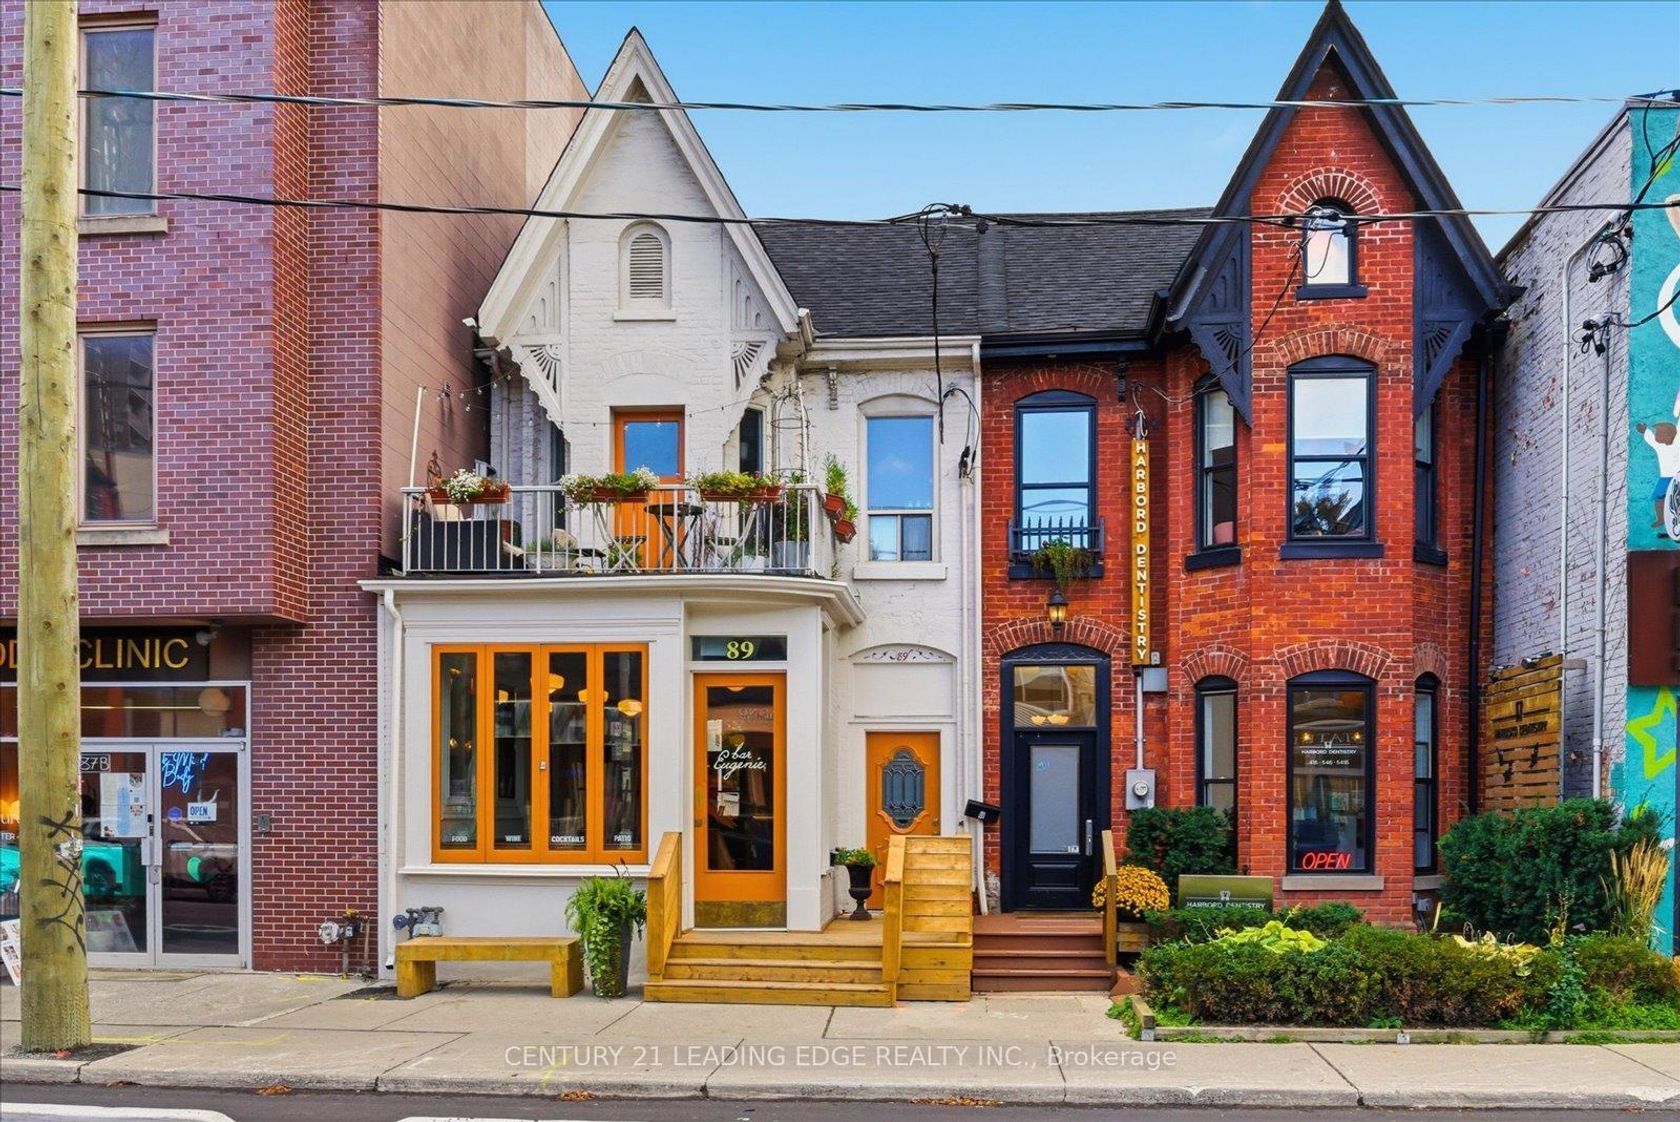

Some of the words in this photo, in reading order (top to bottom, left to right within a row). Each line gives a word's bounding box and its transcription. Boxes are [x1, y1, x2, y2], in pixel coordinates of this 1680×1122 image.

[1135, 442, 1147, 533] HARBORD
[1135, 544, 1147, 660] DENTISTRY
[80, 639, 189, 669] CLINIC
[726, 640, 754, 659] 89
[731, 742, 753, 760] bar
[189, 806, 208, 816] OPEN
[551, 835, 585, 843] COCKTAILS
[1302, 852, 1351, 870] OPEN
